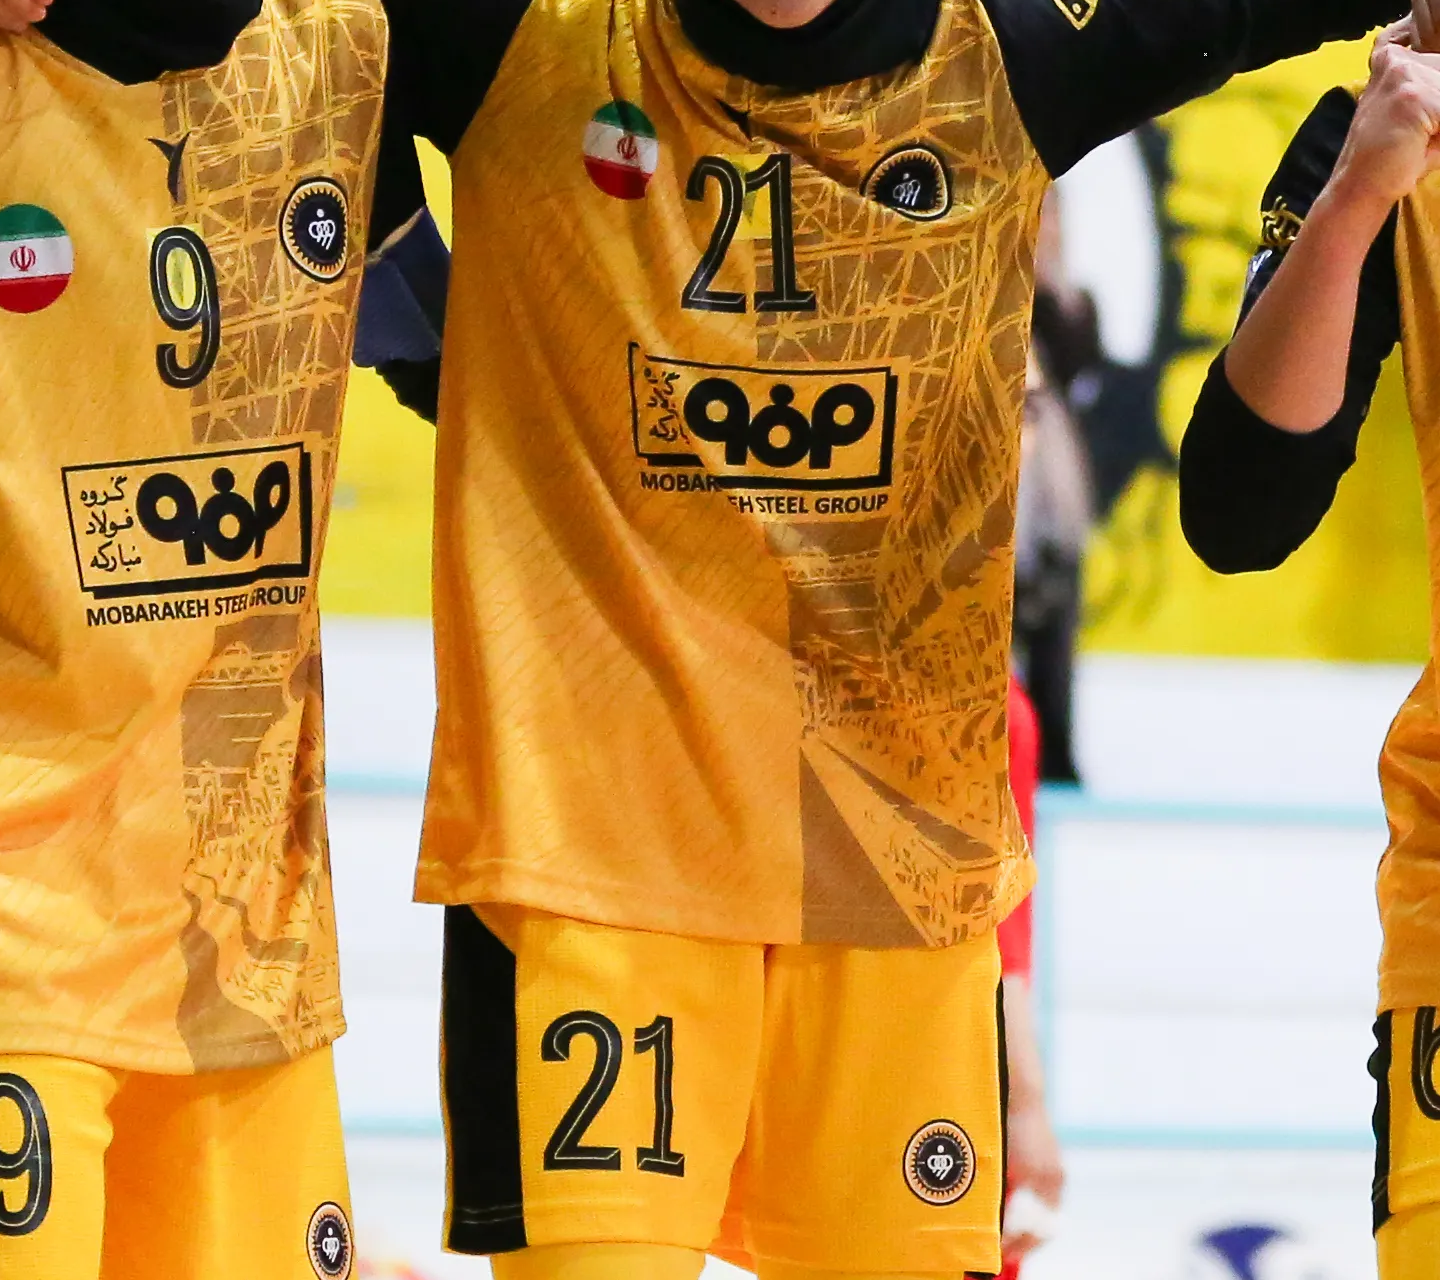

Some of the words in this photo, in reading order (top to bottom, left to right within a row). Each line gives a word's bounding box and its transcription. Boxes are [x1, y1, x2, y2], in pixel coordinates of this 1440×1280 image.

[149, 226, 221, 389] 9
[681, 153, 816, 313] 21
[758, 495, 809, 515] STEEL
[814, 494, 889, 515] GROUP
[86, 598, 209, 628] MOBARAKEH
[540, 1009, 685, 1178] 21
